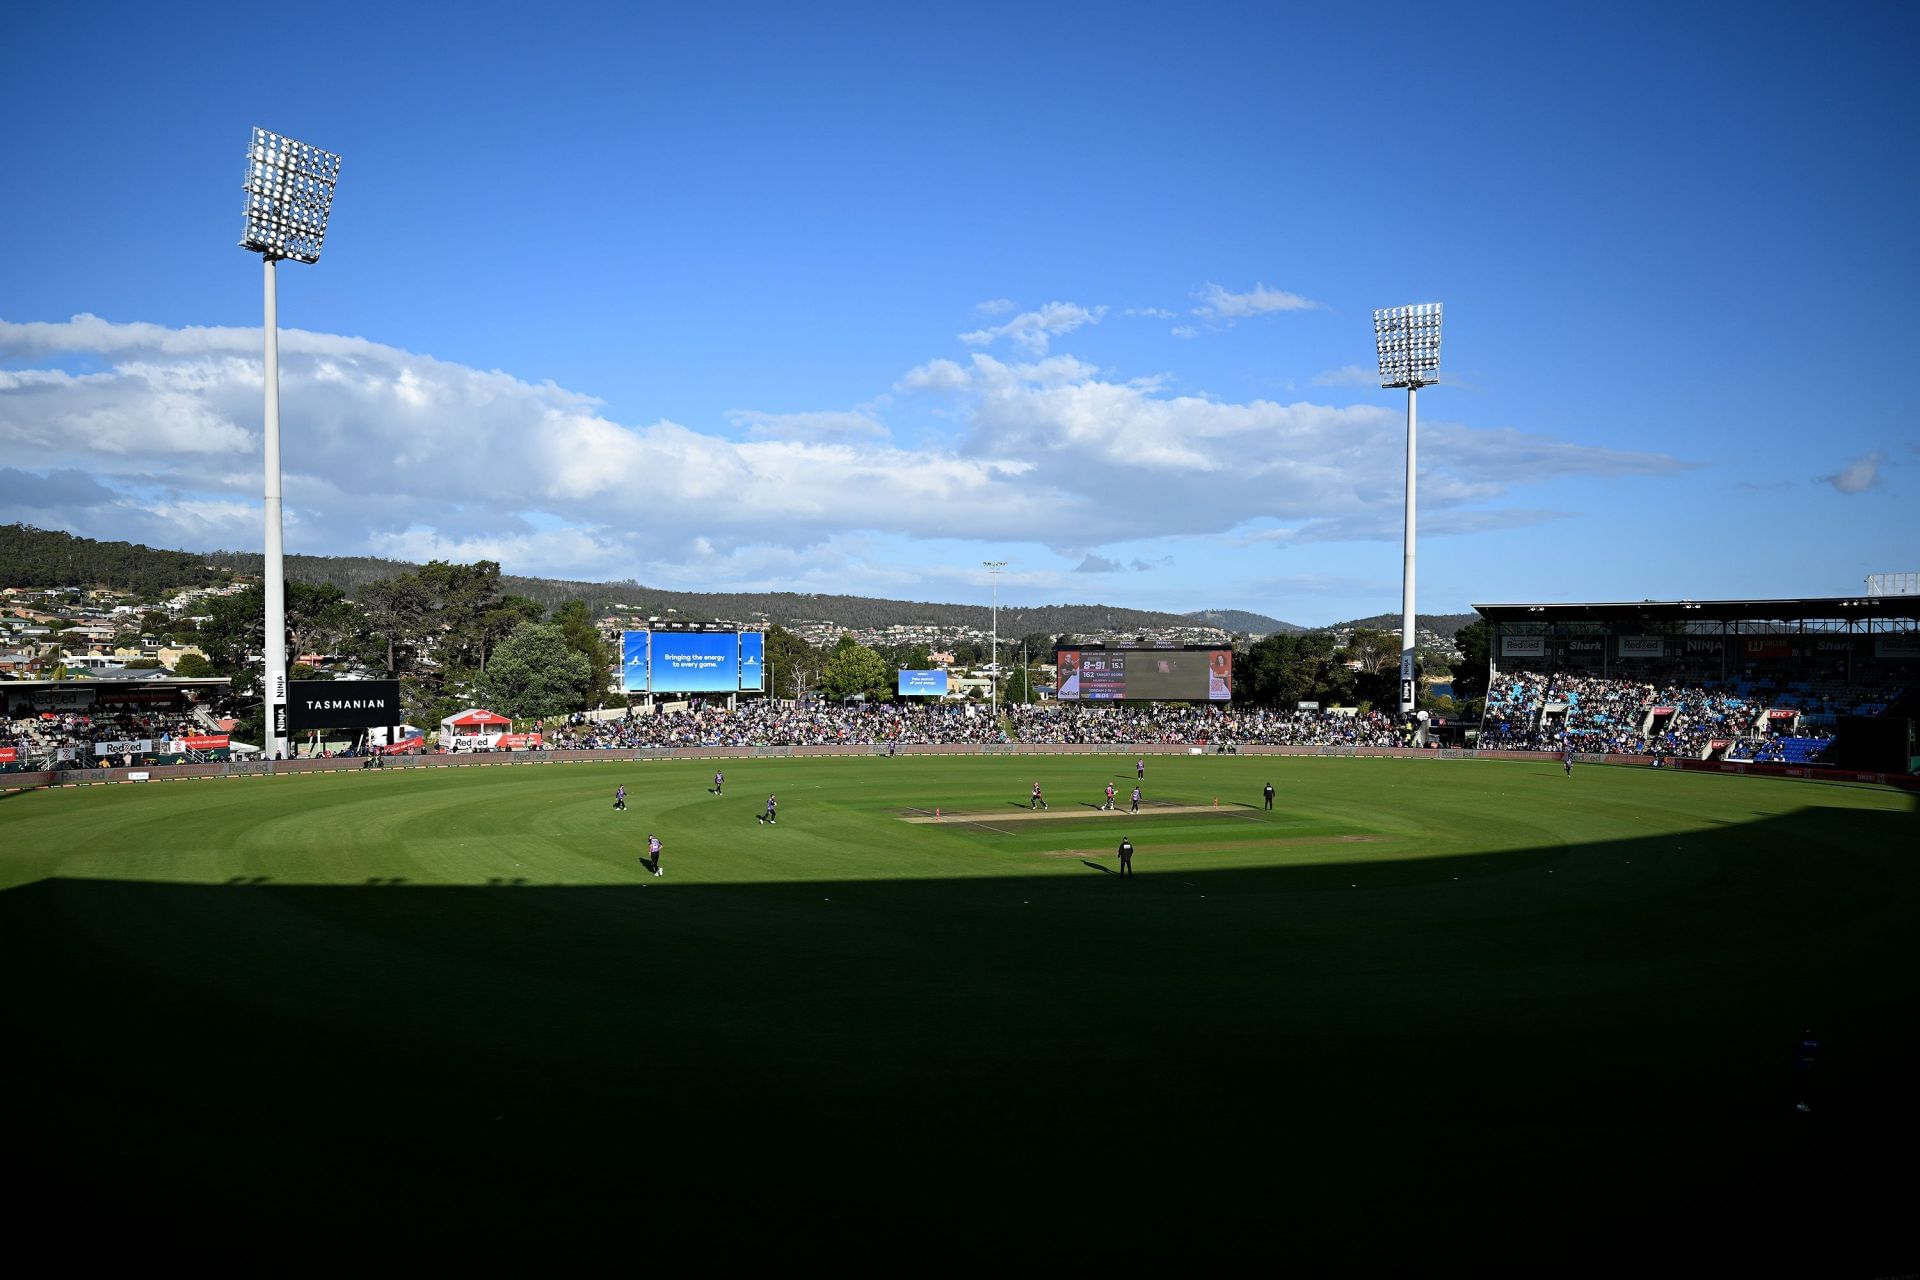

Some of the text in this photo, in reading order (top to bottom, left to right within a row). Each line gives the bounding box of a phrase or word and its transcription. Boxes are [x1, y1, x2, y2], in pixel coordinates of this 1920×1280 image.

[1570, 641, 1601, 650] Shark
[1687, 639, 1723, 653] NINJA
[664, 653, 725, 663] Bringing the energy
[276, 676, 285, 698] NINJA
[306, 700, 386, 710] TASMANIAN
[277, 708, 286, 731] NINJA
[455, 738, 488, 746] RedZed
[107, 742, 143, 754] RedZed
